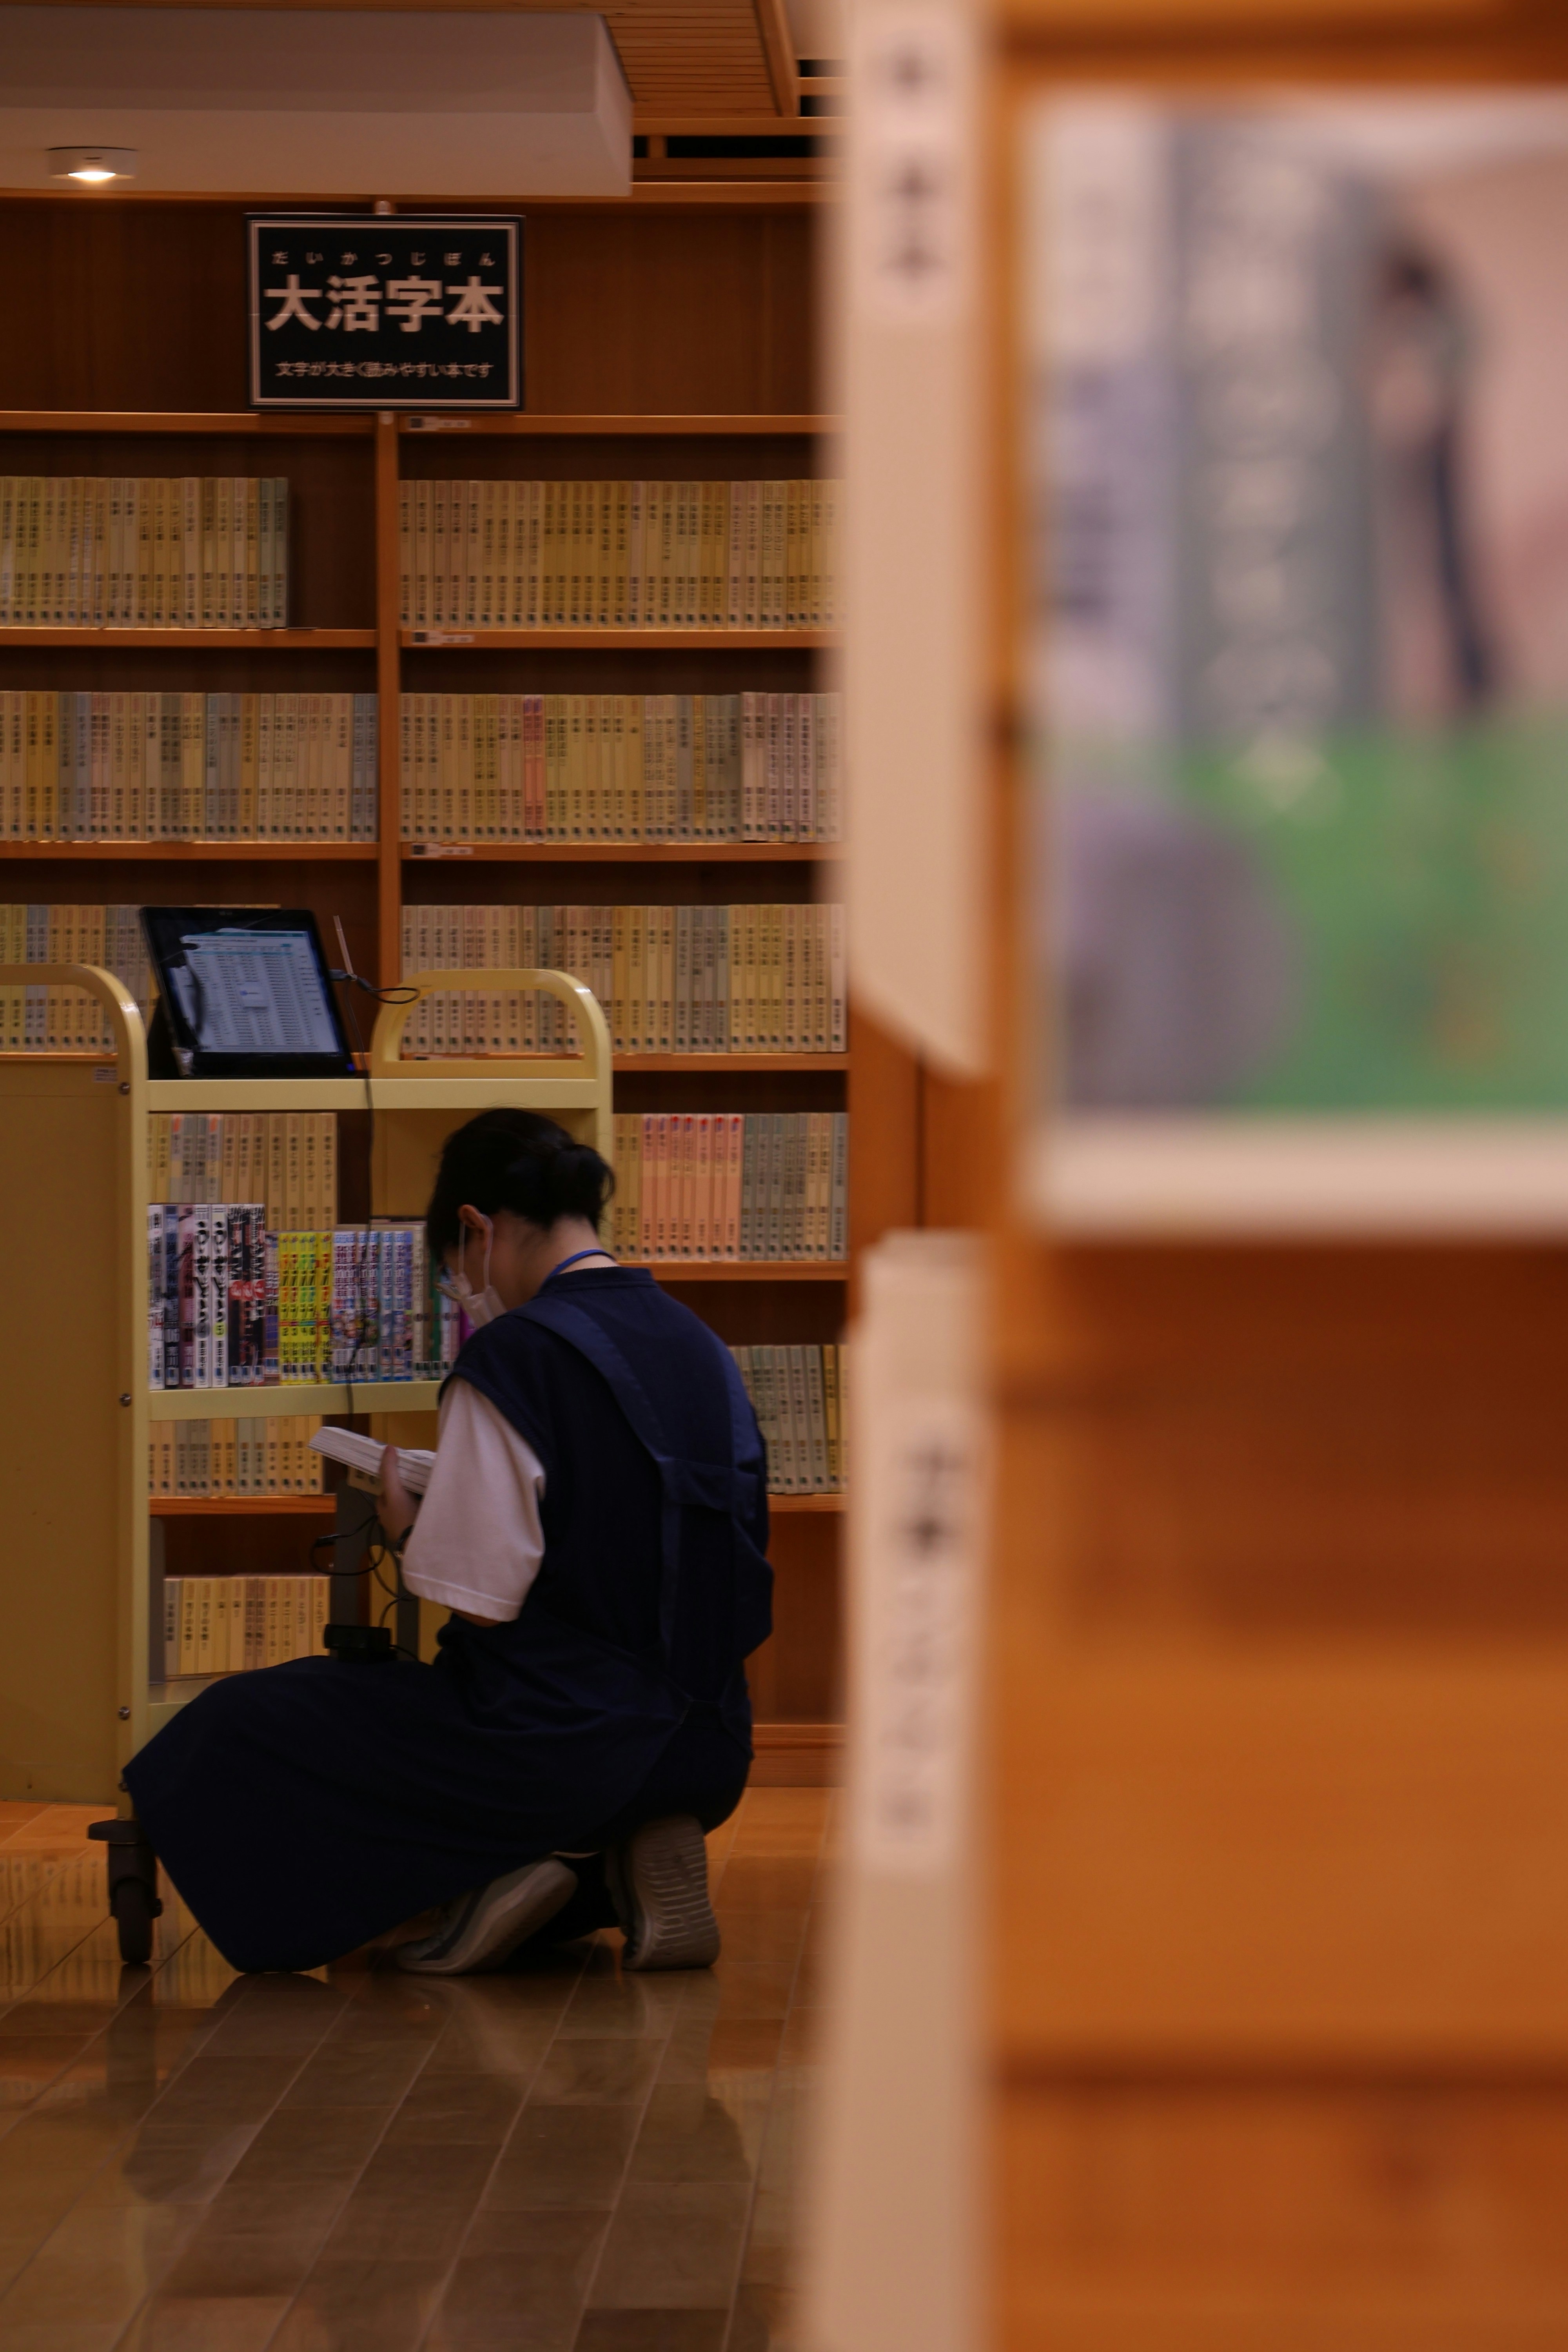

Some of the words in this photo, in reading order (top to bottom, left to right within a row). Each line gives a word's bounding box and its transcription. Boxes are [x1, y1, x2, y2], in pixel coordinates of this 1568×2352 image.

[263, 274, 504, 332] 大活字本
[274, 361, 494, 377] 文字が大きく読みやすい本です
